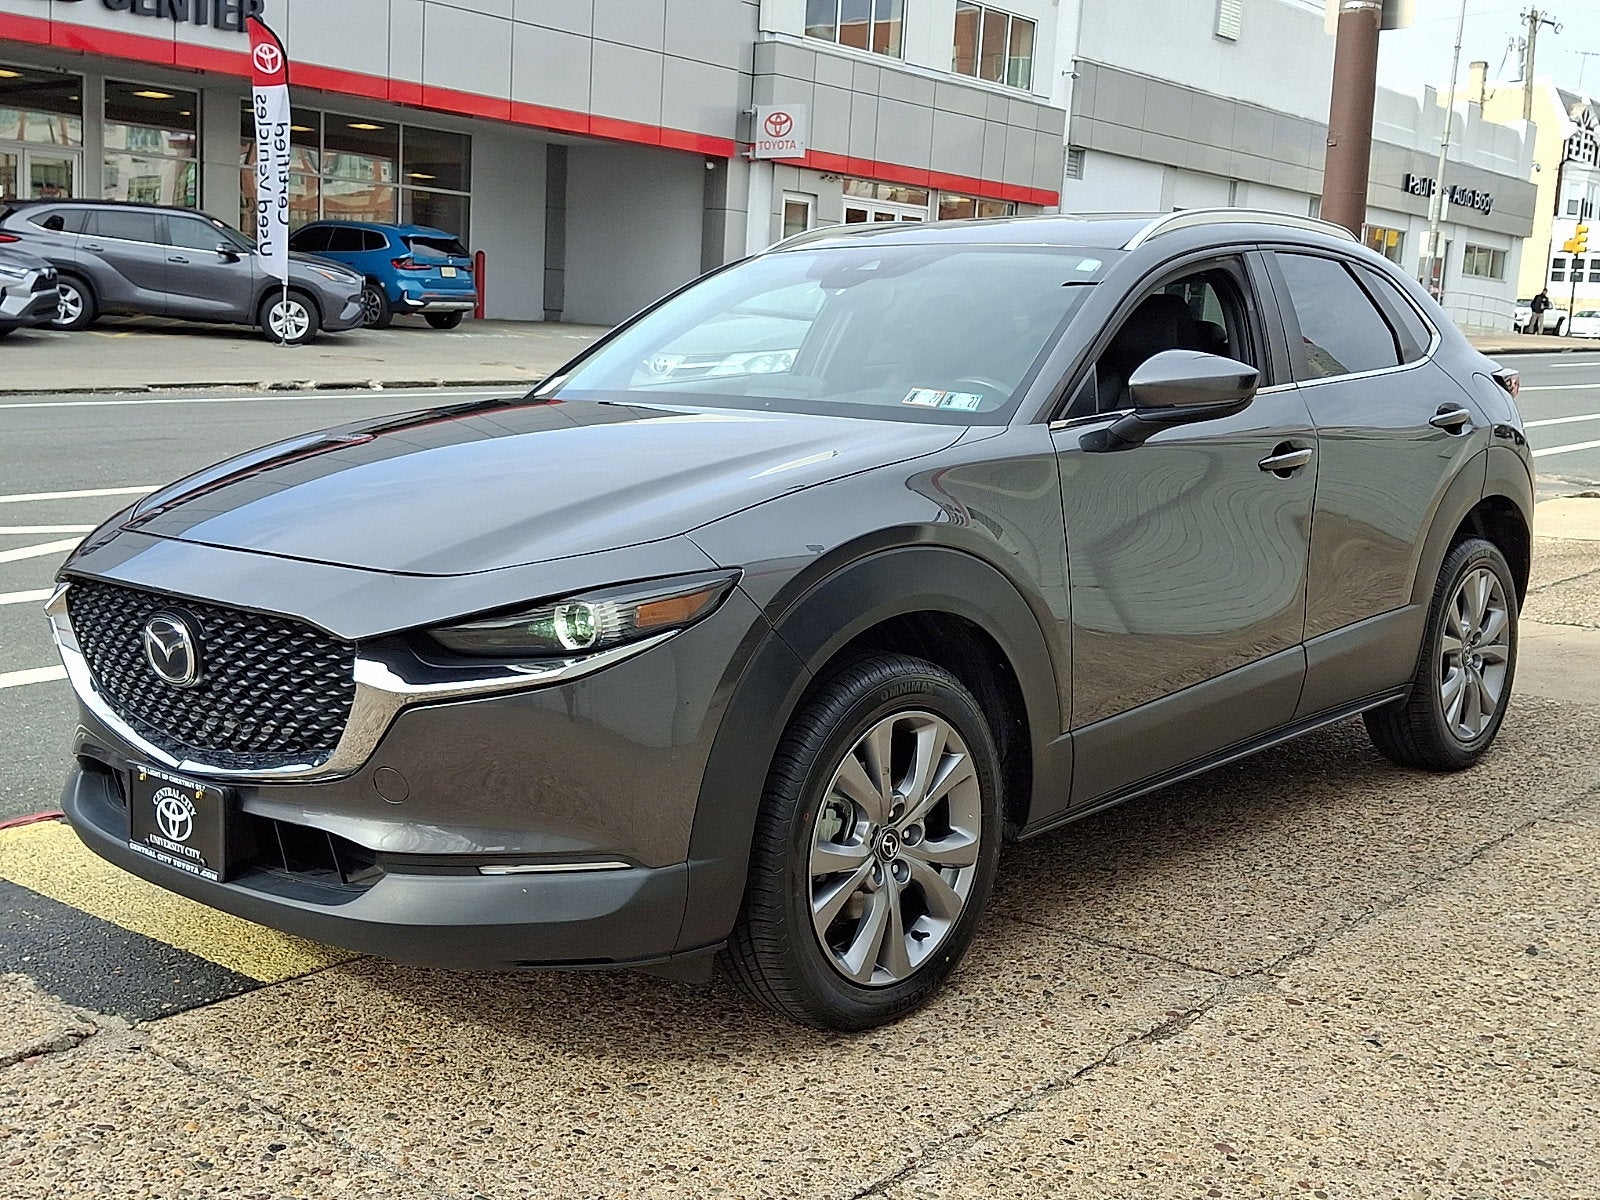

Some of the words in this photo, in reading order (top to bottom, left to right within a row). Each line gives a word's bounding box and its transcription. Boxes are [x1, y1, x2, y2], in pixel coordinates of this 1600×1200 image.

[758, 140, 797, 151] TOYOTA
[1404, 173, 1431, 198] Paul
[1452, 185, 1474, 207] Auto
[1473, 190, 1494, 216] Body
[153, 786, 181, 806] CENTRAL
[180, 793, 198, 817] CITY
[129, 842, 157, 859] CENTRAL
[156, 853, 172, 864] CITY
[172, 858, 200, 875] TOYOTA
[149, 833, 186, 855] UNIVERSITY
[185, 846, 201, 860] CITY
